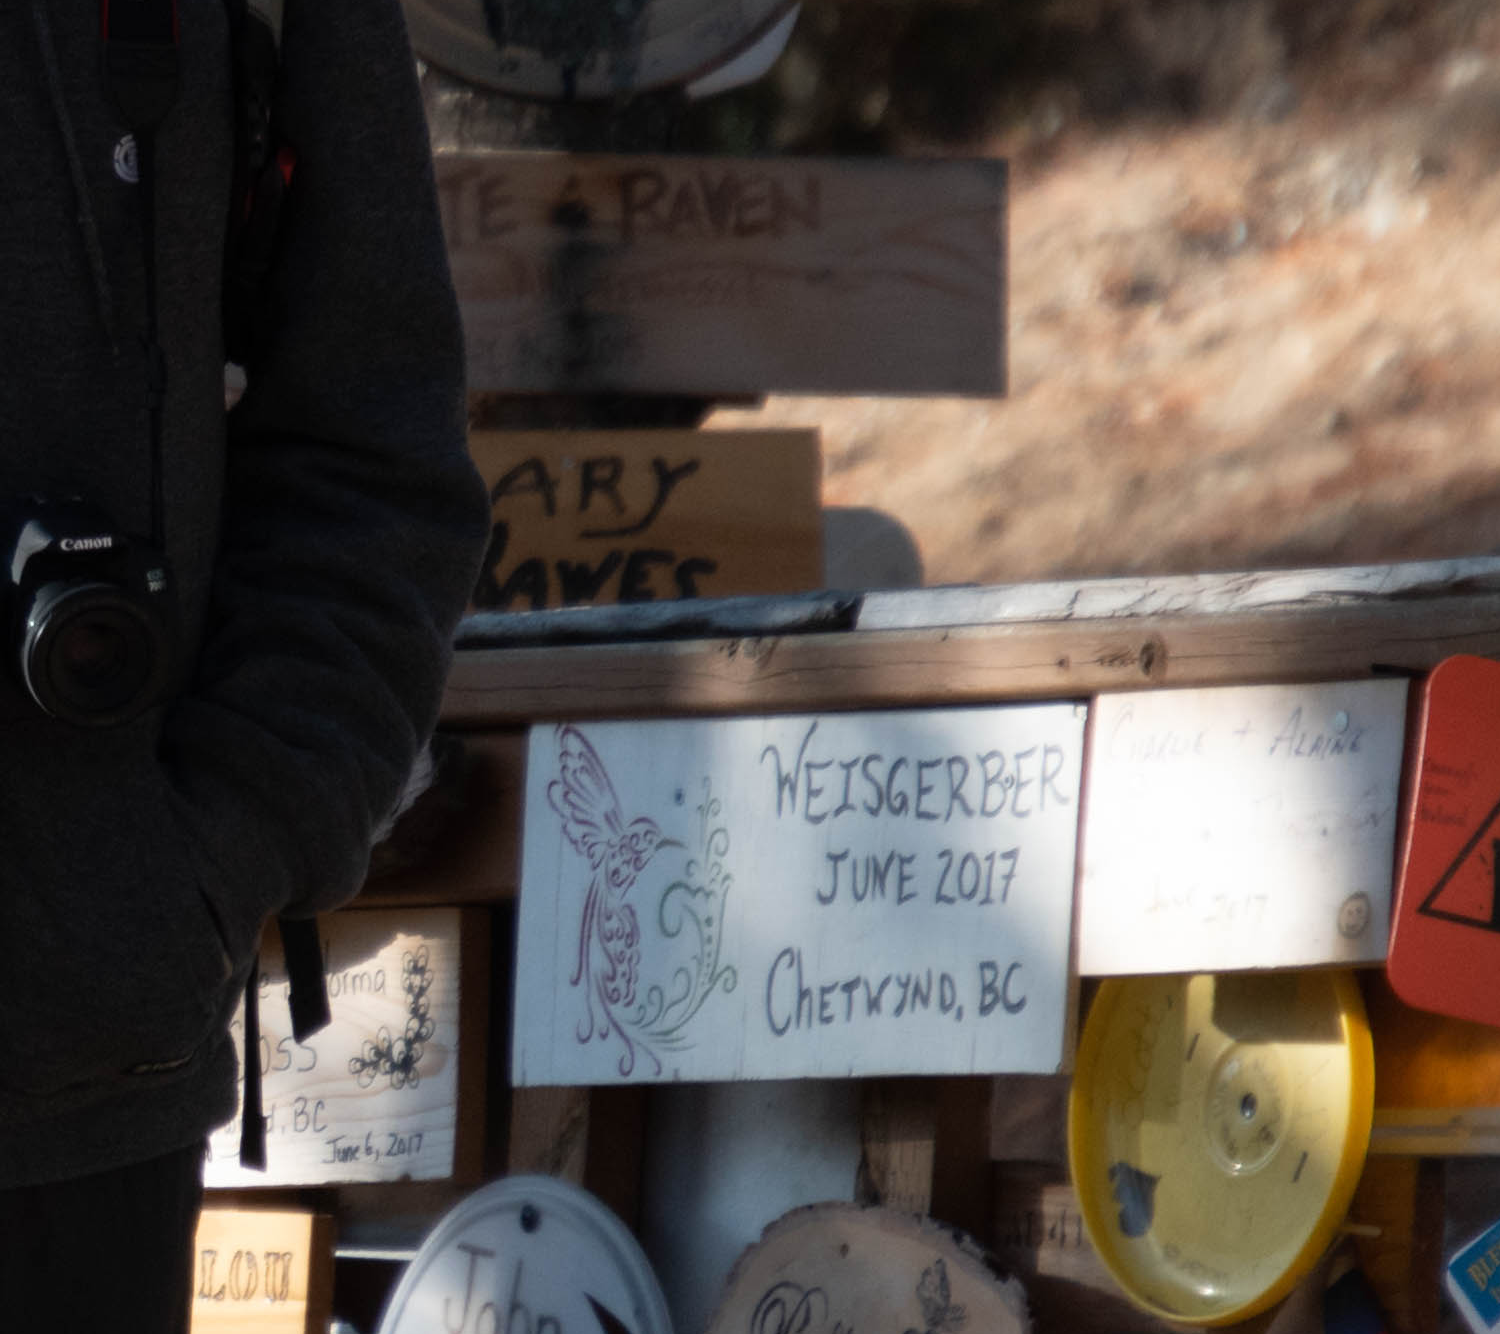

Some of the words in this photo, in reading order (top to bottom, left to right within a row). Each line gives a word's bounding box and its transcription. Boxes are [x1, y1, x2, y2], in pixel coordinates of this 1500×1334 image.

[59, 535, 113, 552] Canon
[760, 723, 1072, 823] WEISGERBER
[816, 852, 916, 907] JUNE
[934, 847, 1020, 907] 2017
[977, 961, 1028, 1018] BC
[322, 1134, 361, 1165] June
